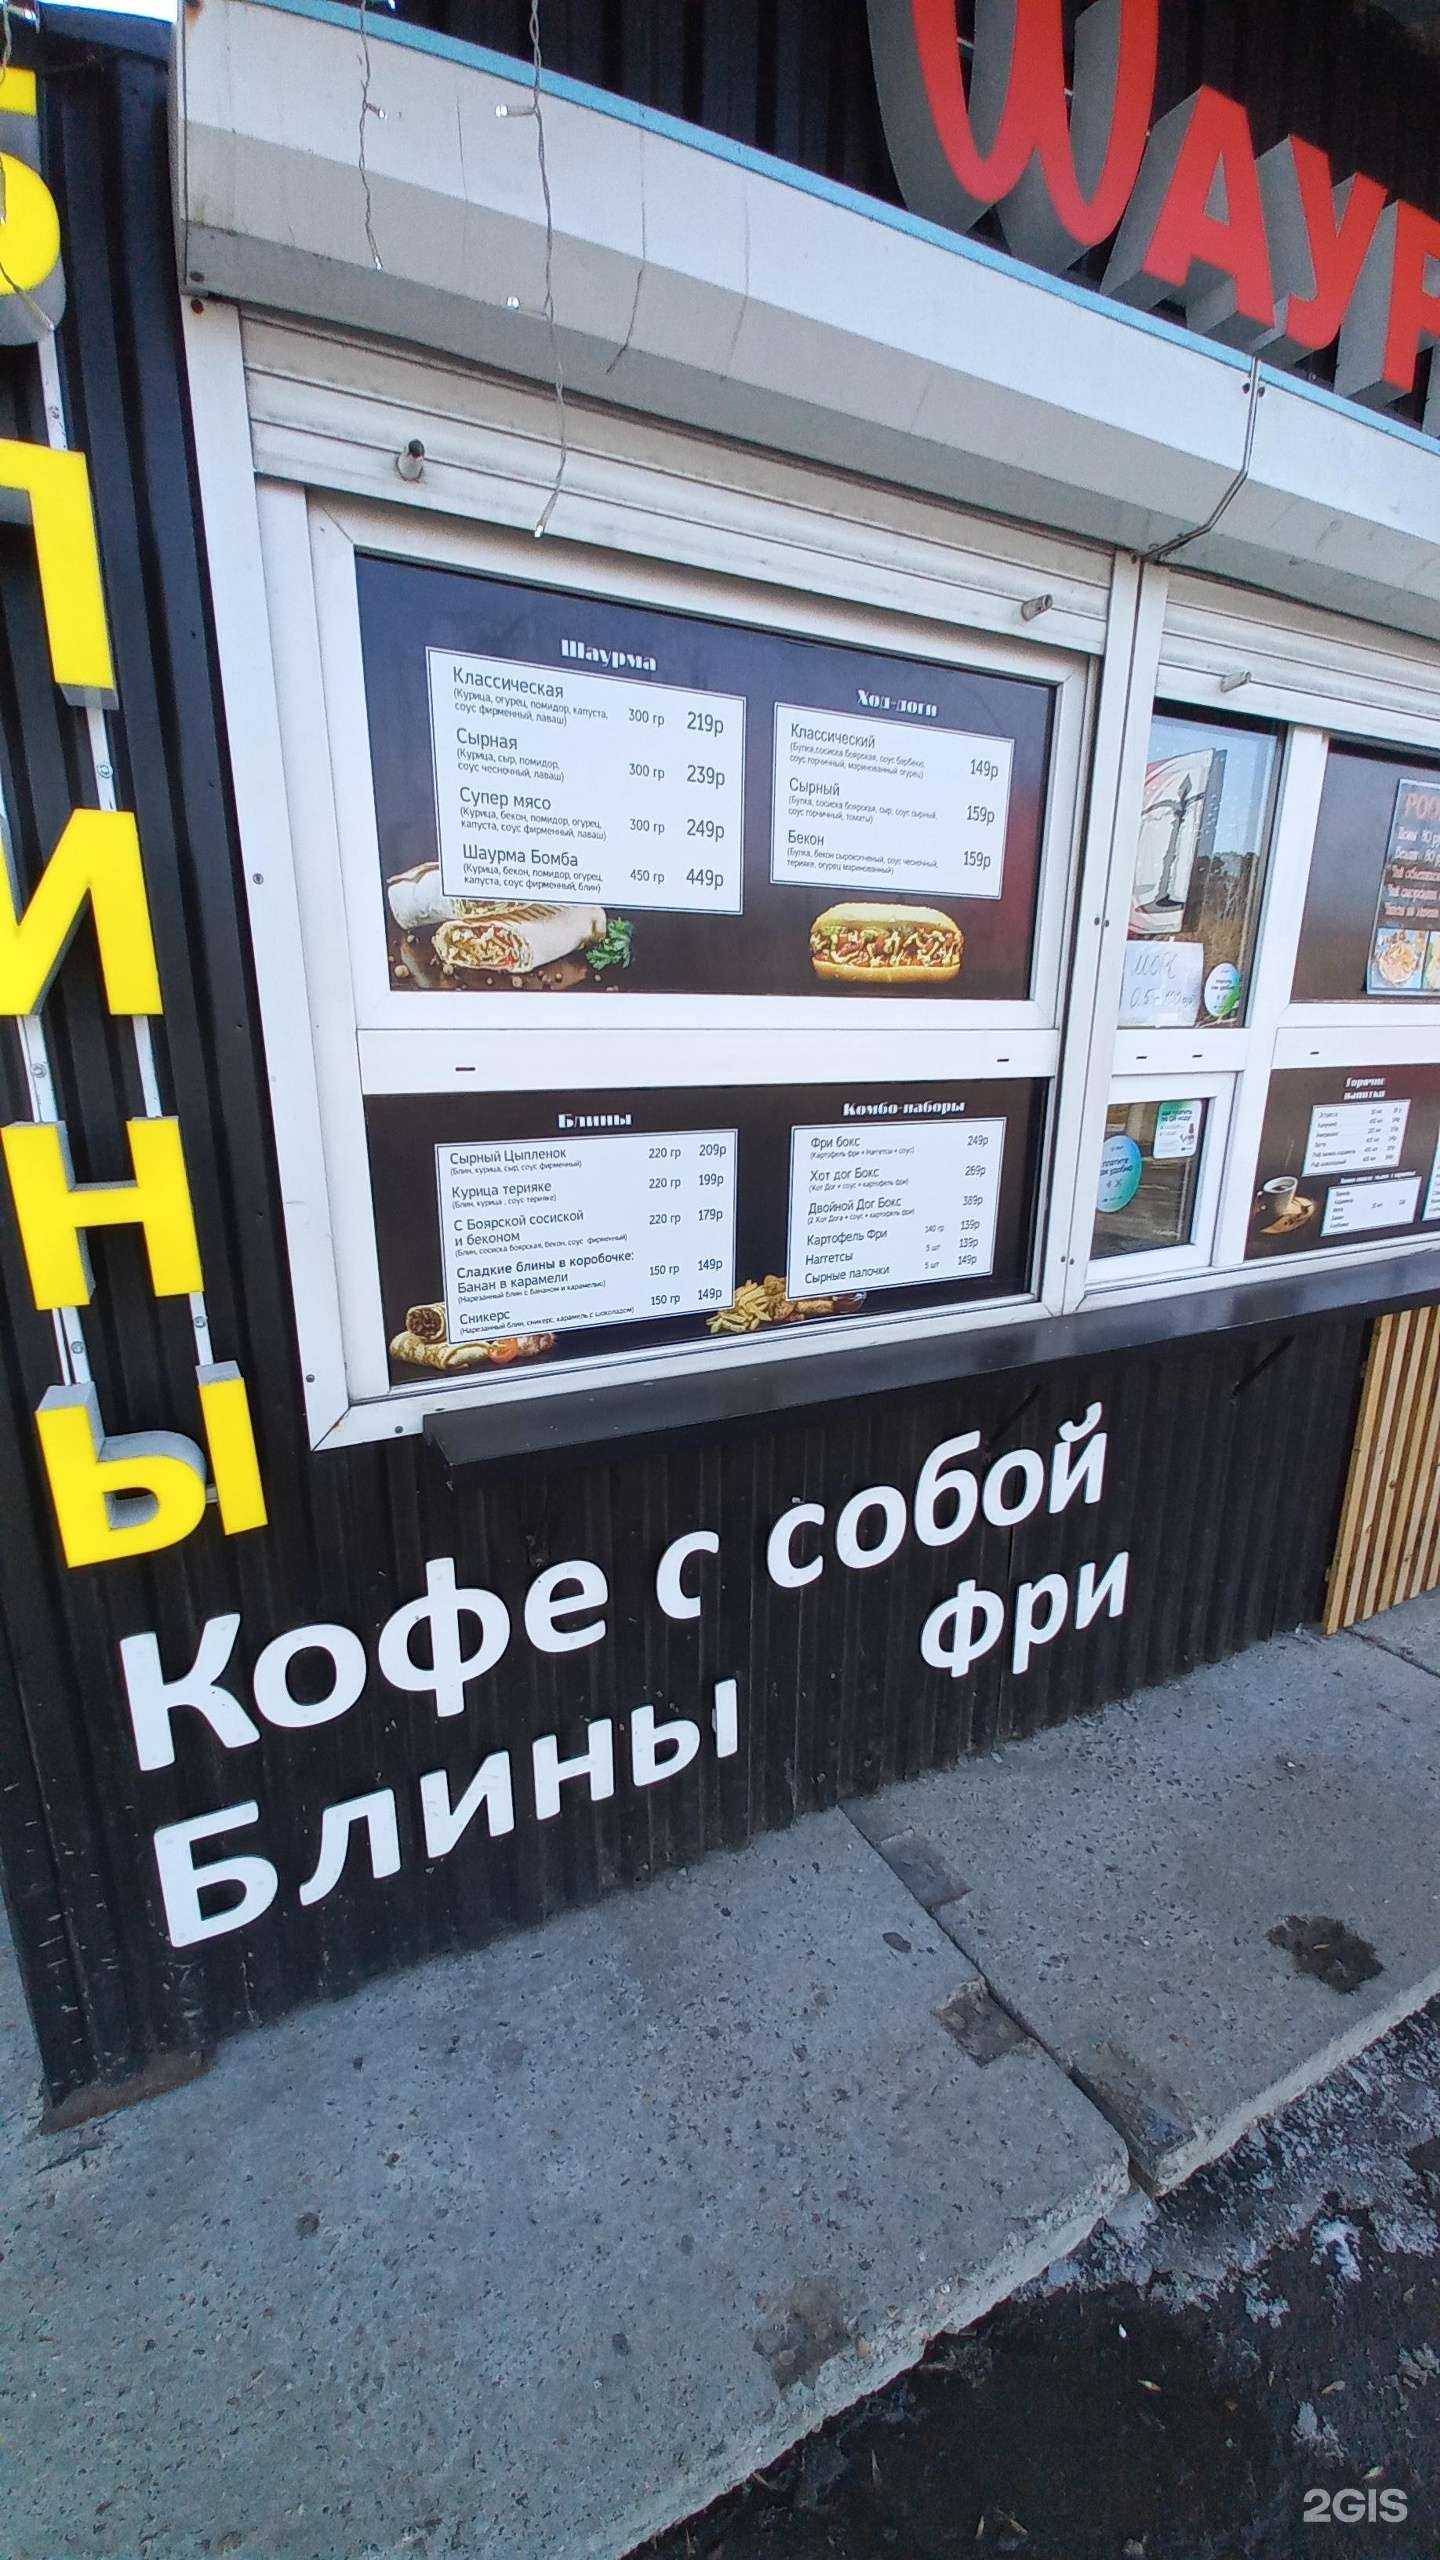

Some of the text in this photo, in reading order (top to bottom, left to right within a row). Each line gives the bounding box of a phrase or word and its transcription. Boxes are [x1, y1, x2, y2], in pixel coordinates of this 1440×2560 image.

[561, 639, 658, 671] Шаурма
[453, 667, 563, 698] Классическая
[629, 708, 665, 728] 300 гр
[687, 711, 724, 737] 219р
[457, 728, 517, 750] Сырная
[791, 723, 875, 748] Классический
[629, 763, 665, 780] 300 гр
[687, 764, 725, 789] 239р
[971, 759, 998, 781] 149р
[789, 777, 840, 796] Сырный
[460, 787, 551, 810] Супер мясо
[967, 805, 995, 826] 159р
[630, 818, 665, 836] 300 гр
[687, 819, 724, 842] 249р
[788, 829, 824, 846] Бекон
[463, 844, 578, 867] Шаурма Бомба
[964, 851, 991, 870] 159р
[630, 869, 665, 885] 450 гр
[686, 869, 724, 890] 449р
[557, 1113, 633, 1129] Блины
[811, 1136, 860, 1151] Фри бокс
[967, 1135, 989, 1147] 249р
[450, 1149, 566, 1166] Сырный Цыпленок
[649, 1147, 681, 1160] 220 гр
[699, 1144, 727, 1158] 209р
[649, 1177, 681, 1189] 220 гр
[699, 1173, 724, 1187] 199р
[810, 1167, 880, 1182] Хот дог Бокс
[452, 1183, 551, 1200] Курица терияке
[698, 1208, 723, 1222] 179р
[808, 1197, 901, 1215] Двойной Дог Бокс
[453, 1210, 584, 1231] С Боярской сосиской
[649, 1213, 681, 1225] 220 гр
[454, 1233, 520, 1247] и беконом
[807, 1229, 887, 1247] Картофель Фри
[457, 1252, 634, 1278] Сладкие блины в коробочке:
[698, 1258, 723, 1271] 149р
[805, 1253, 853, 1265] Наггетсы
[650, 1265, 680, 1276] 150 гр
[805, 1266, 890, 1285] Сырные палочки
[458, 1274, 568, 1293] Банан в карамели
[651, 1294, 681, 1306] 150 гр
[698, 1288, 722, 1300] 149р
[460, 1311, 510, 1325] Сникерс
[118, 1400, 1110, 1774] Кофе с собой
[920, 1551, 1129, 1678] Фри
[151, 1677, 740, 1949] Блины
